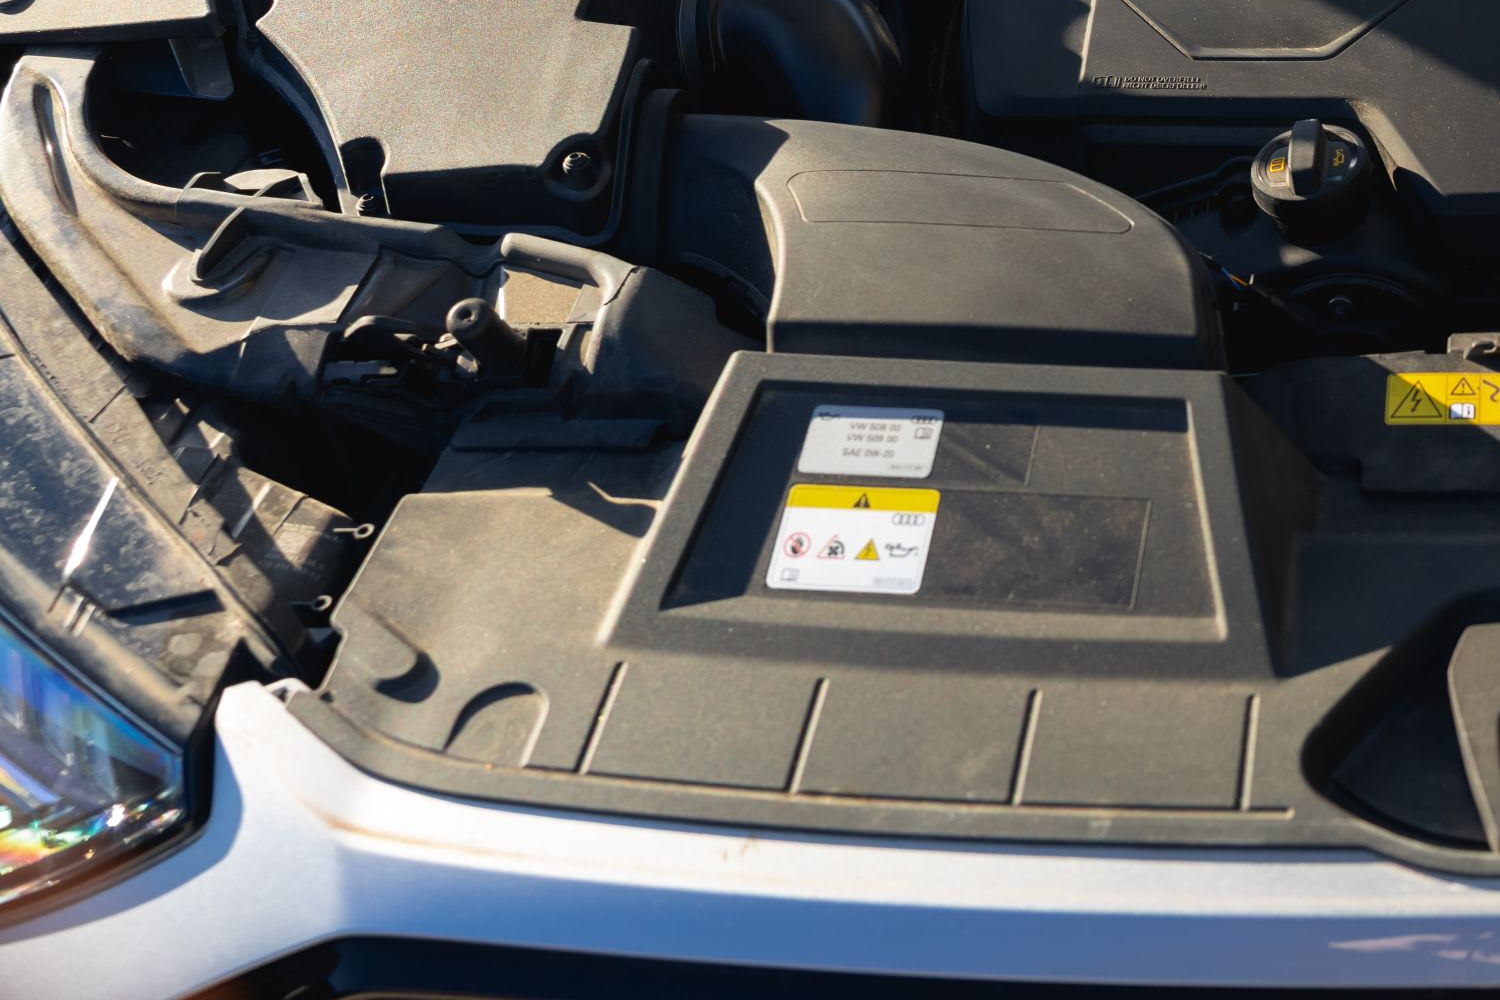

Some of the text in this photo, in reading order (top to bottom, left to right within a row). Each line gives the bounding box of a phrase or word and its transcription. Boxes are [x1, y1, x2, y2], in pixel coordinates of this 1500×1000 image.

[849, 423, 867, 431] VW
[847, 433, 864, 441] VW
[841, 448, 862, 457] SAE
